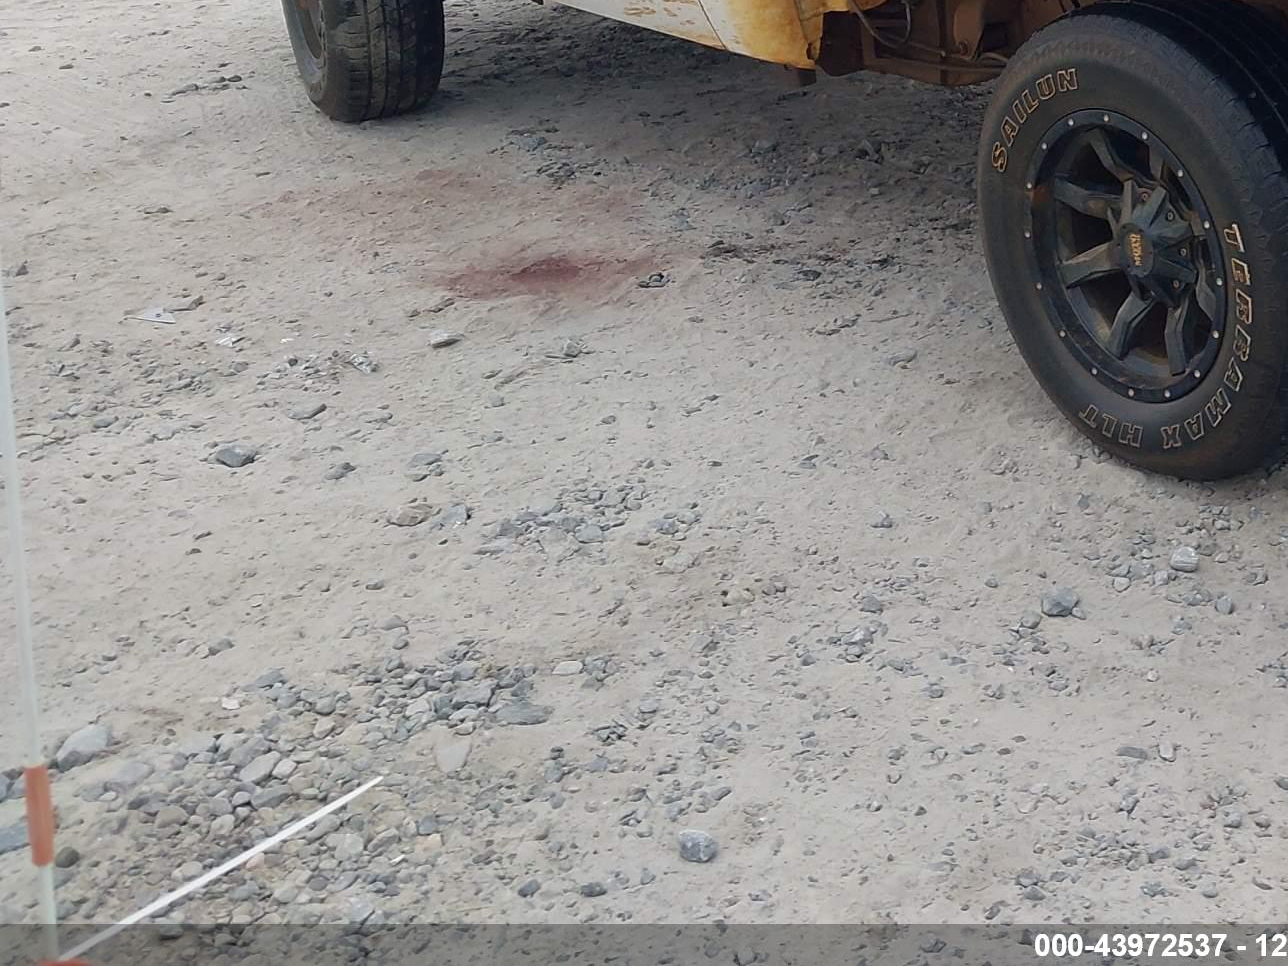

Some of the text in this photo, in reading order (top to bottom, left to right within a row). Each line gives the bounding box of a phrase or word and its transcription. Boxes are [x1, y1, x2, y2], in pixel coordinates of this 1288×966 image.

[991, 68, 1078, 172] SAILUN
[1079, 223, 1252, 449] TERRAMAX HLT
